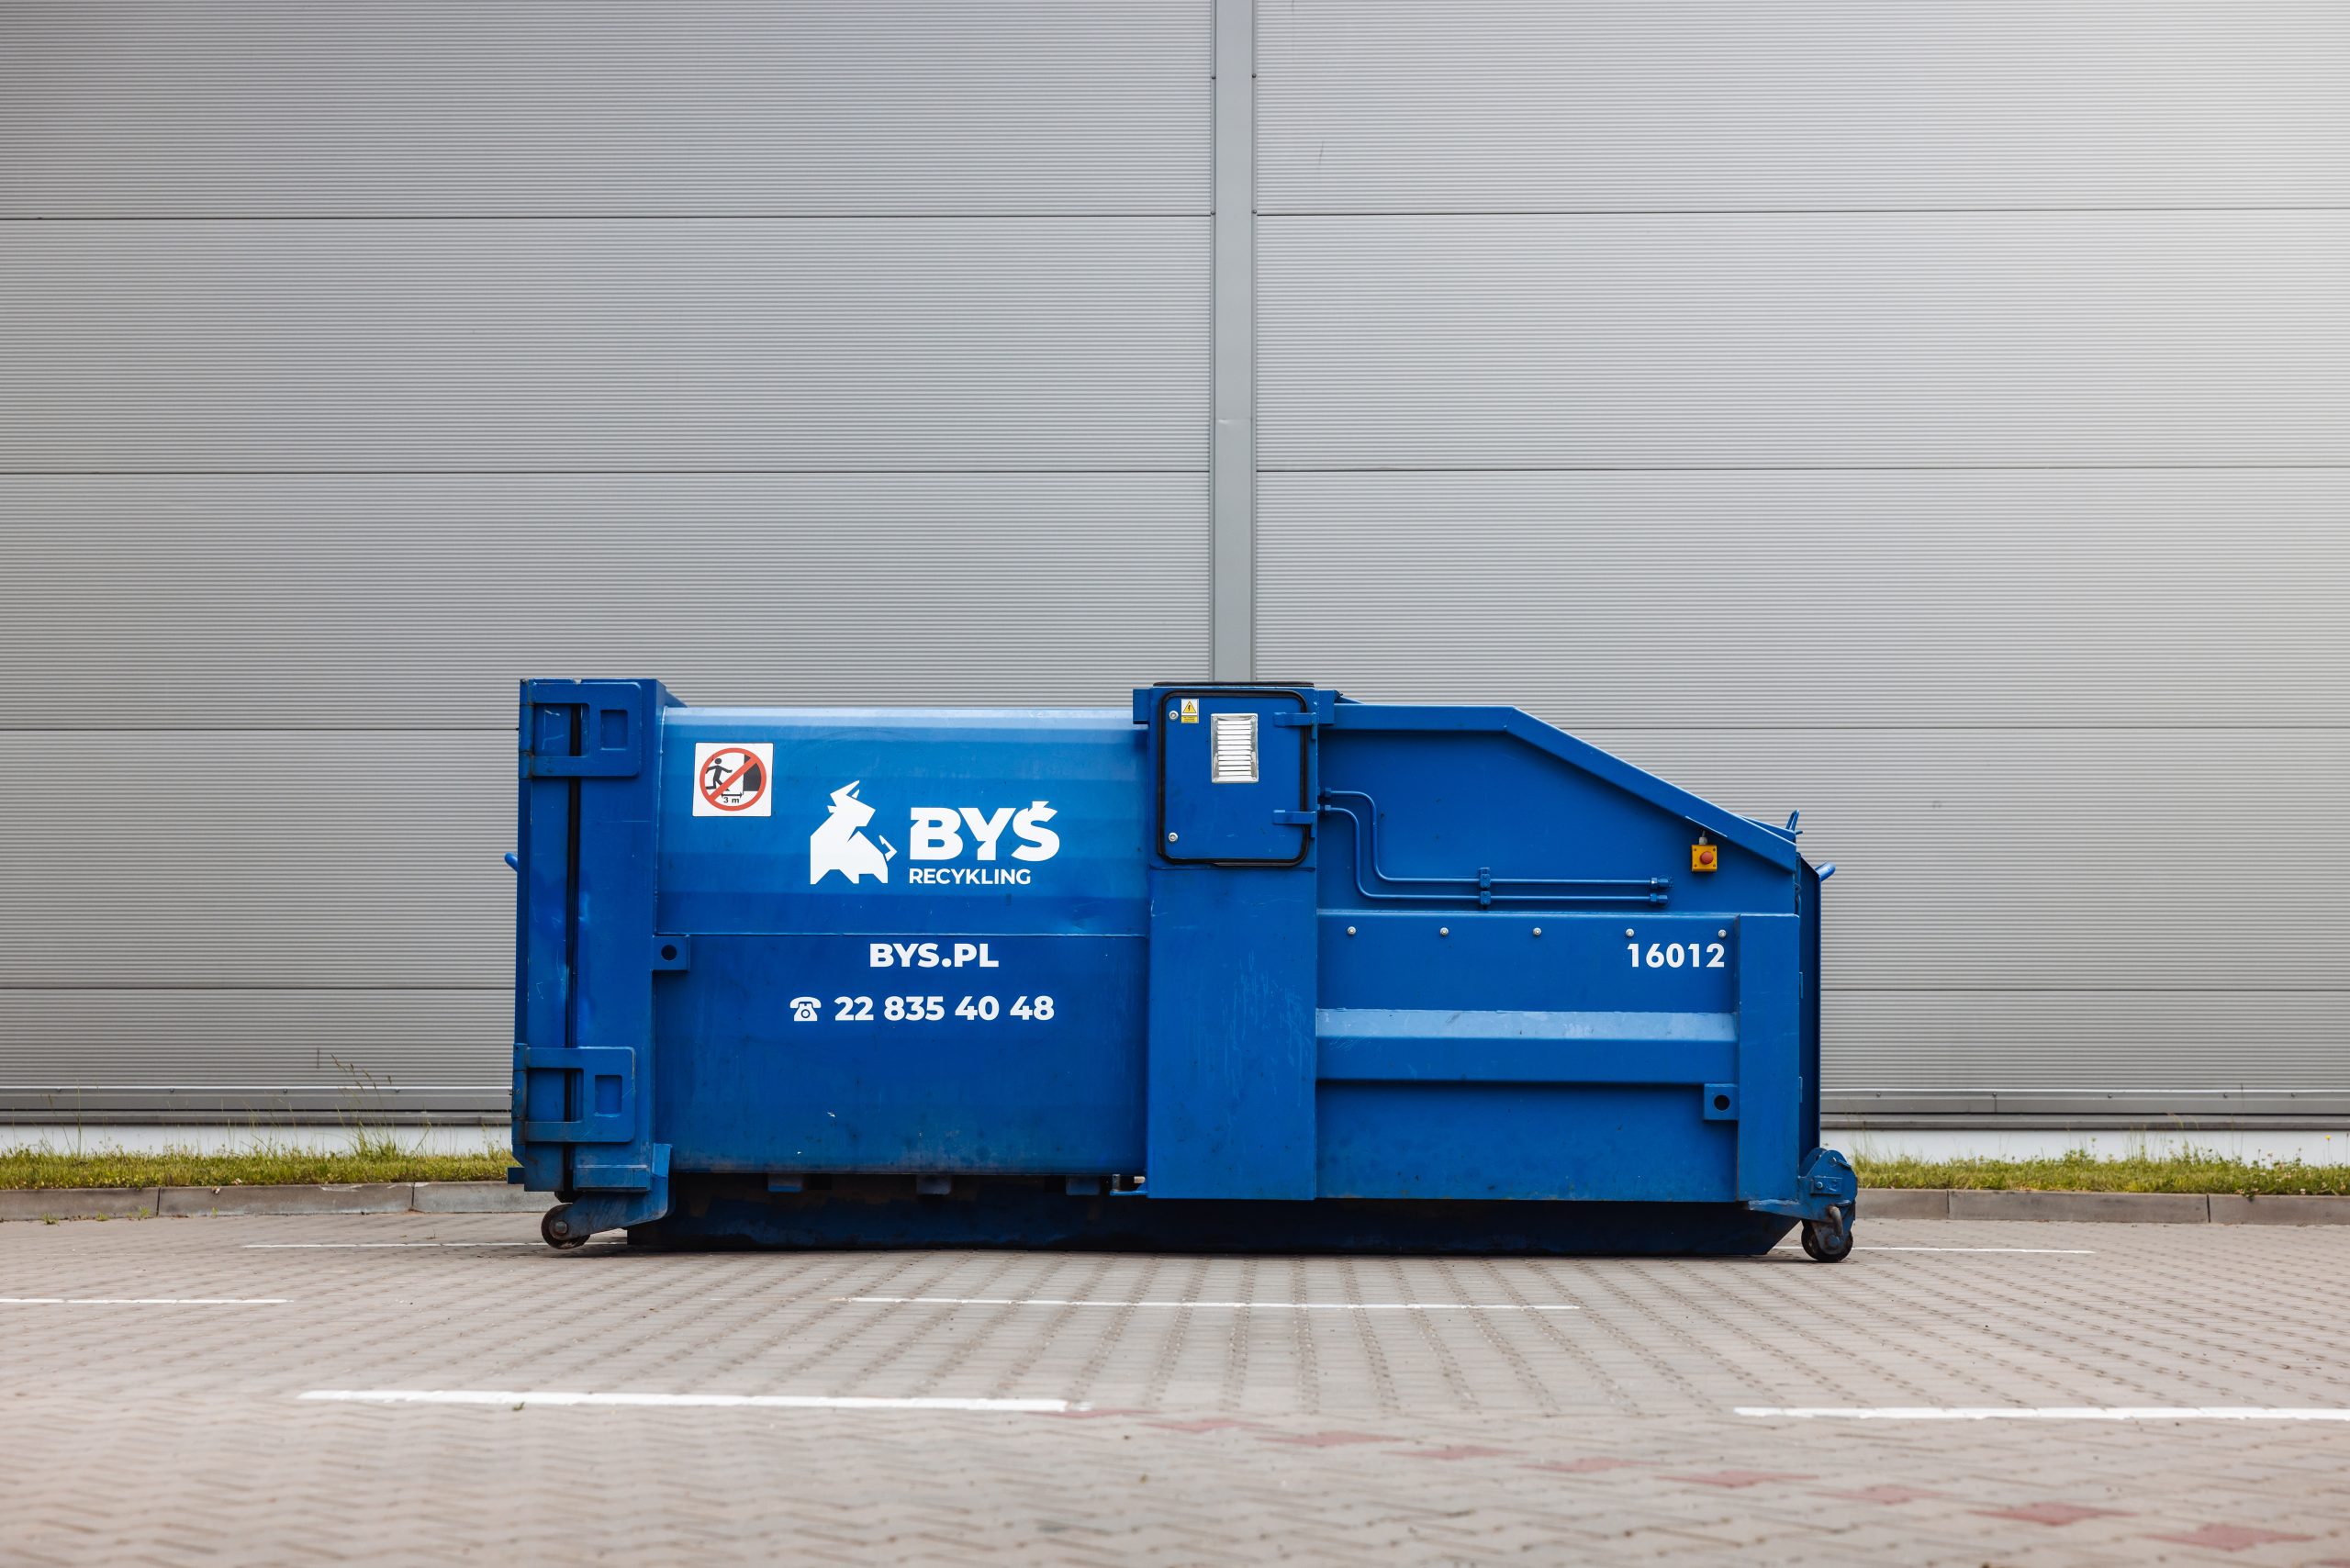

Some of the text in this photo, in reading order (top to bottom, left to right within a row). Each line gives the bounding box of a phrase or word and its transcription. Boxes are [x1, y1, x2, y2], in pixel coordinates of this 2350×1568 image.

[910, 801, 1060, 862] BYŚ
[909, 868, 1031, 885] RECYKLING
[869, 942, 1000, 968] BYS.PL
[1627, 943, 1725, 969] 16012
[834, 995, 1055, 1022] 22 835 40 48
